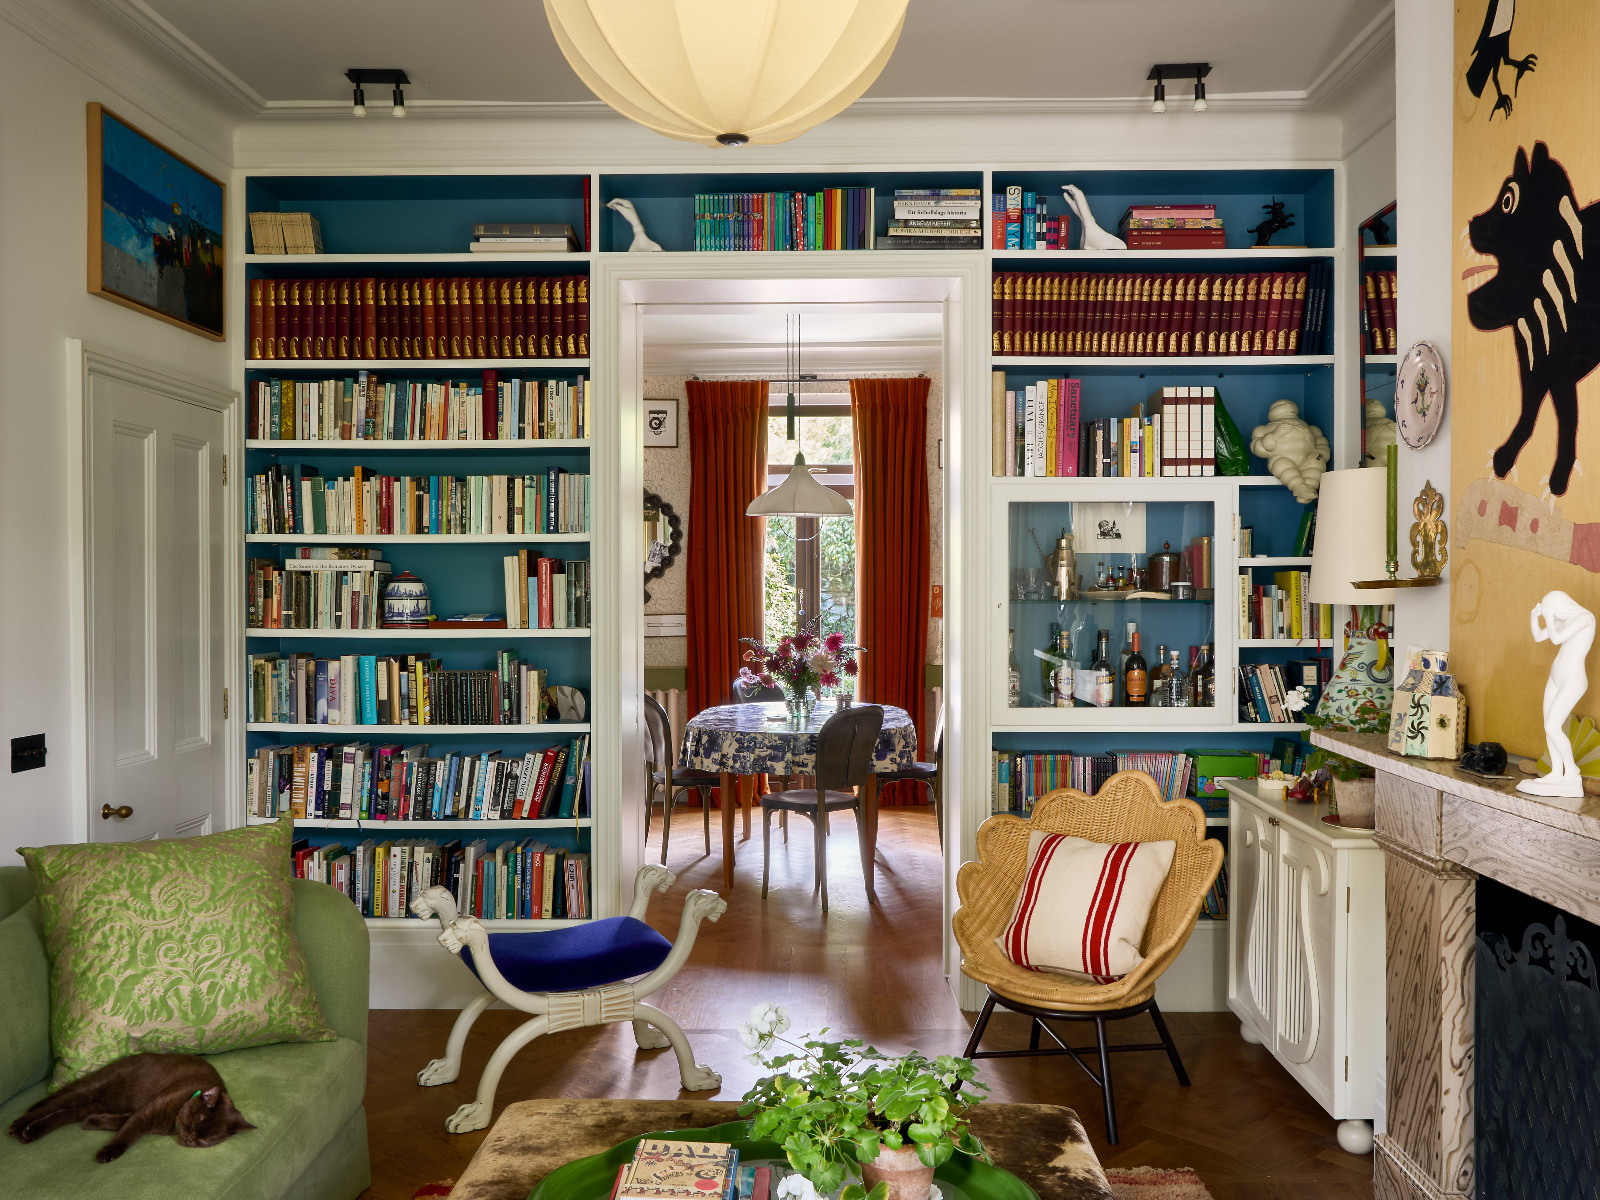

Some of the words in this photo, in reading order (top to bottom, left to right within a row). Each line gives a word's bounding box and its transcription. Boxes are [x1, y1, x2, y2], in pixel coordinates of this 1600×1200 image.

[1067, 383, 1080, 439] Sanctuary
[329, 678, 337, 702] DIVA
[292, 768, 306, 803] HAMILTON
[476, 755, 487, 798] PERSEPOLIS
